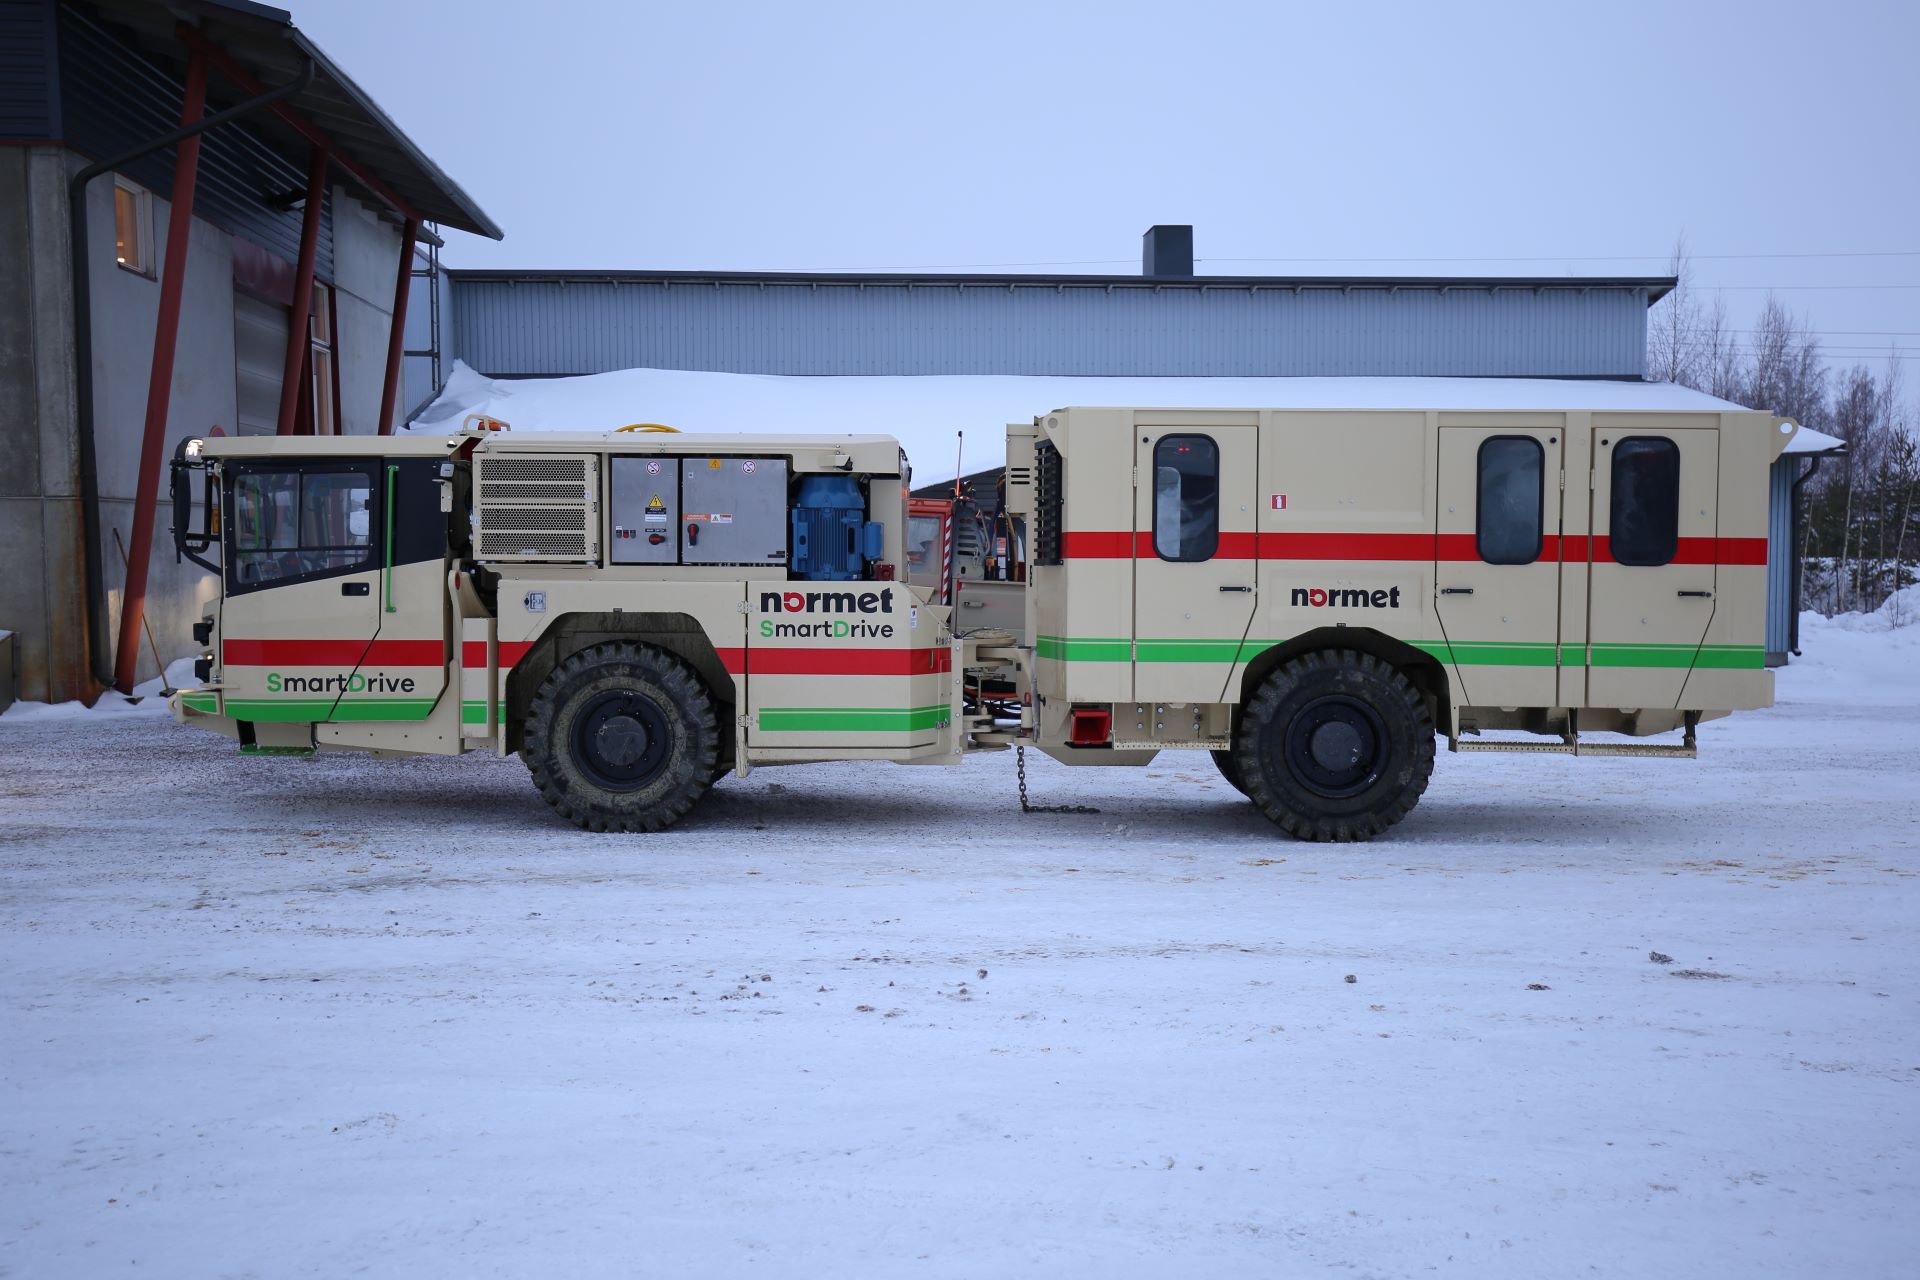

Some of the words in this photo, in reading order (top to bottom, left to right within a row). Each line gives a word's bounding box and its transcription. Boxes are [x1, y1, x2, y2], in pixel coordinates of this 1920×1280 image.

[760, 587, 893, 613] normet
[1291, 585, 1400, 608] normet
[760, 619, 894, 638] SmartDrive
[266, 672, 415, 693] SmartDrive
